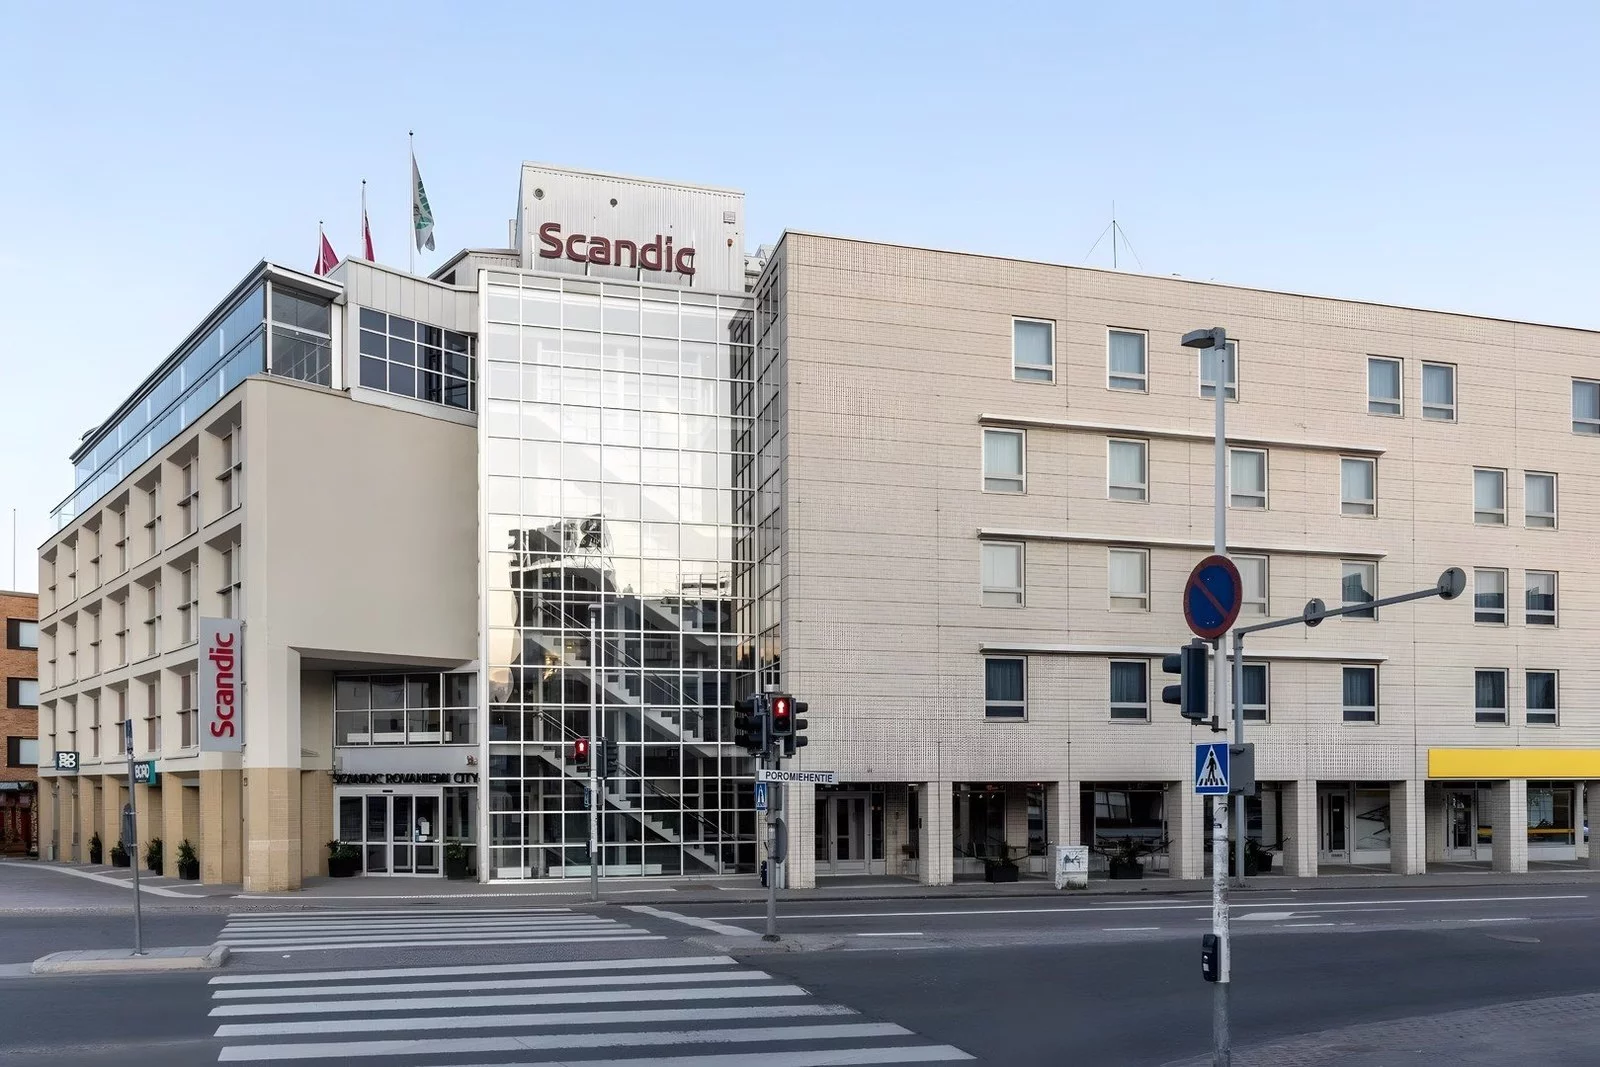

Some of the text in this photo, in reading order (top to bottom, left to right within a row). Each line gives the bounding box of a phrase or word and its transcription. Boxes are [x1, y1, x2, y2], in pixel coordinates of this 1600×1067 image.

[539, 222, 696, 275] Scandic
[209, 632, 235, 737] Scandic
[453, 772, 479, 784] CITY
[765, 771, 833, 783] POROMIEHENTIE
